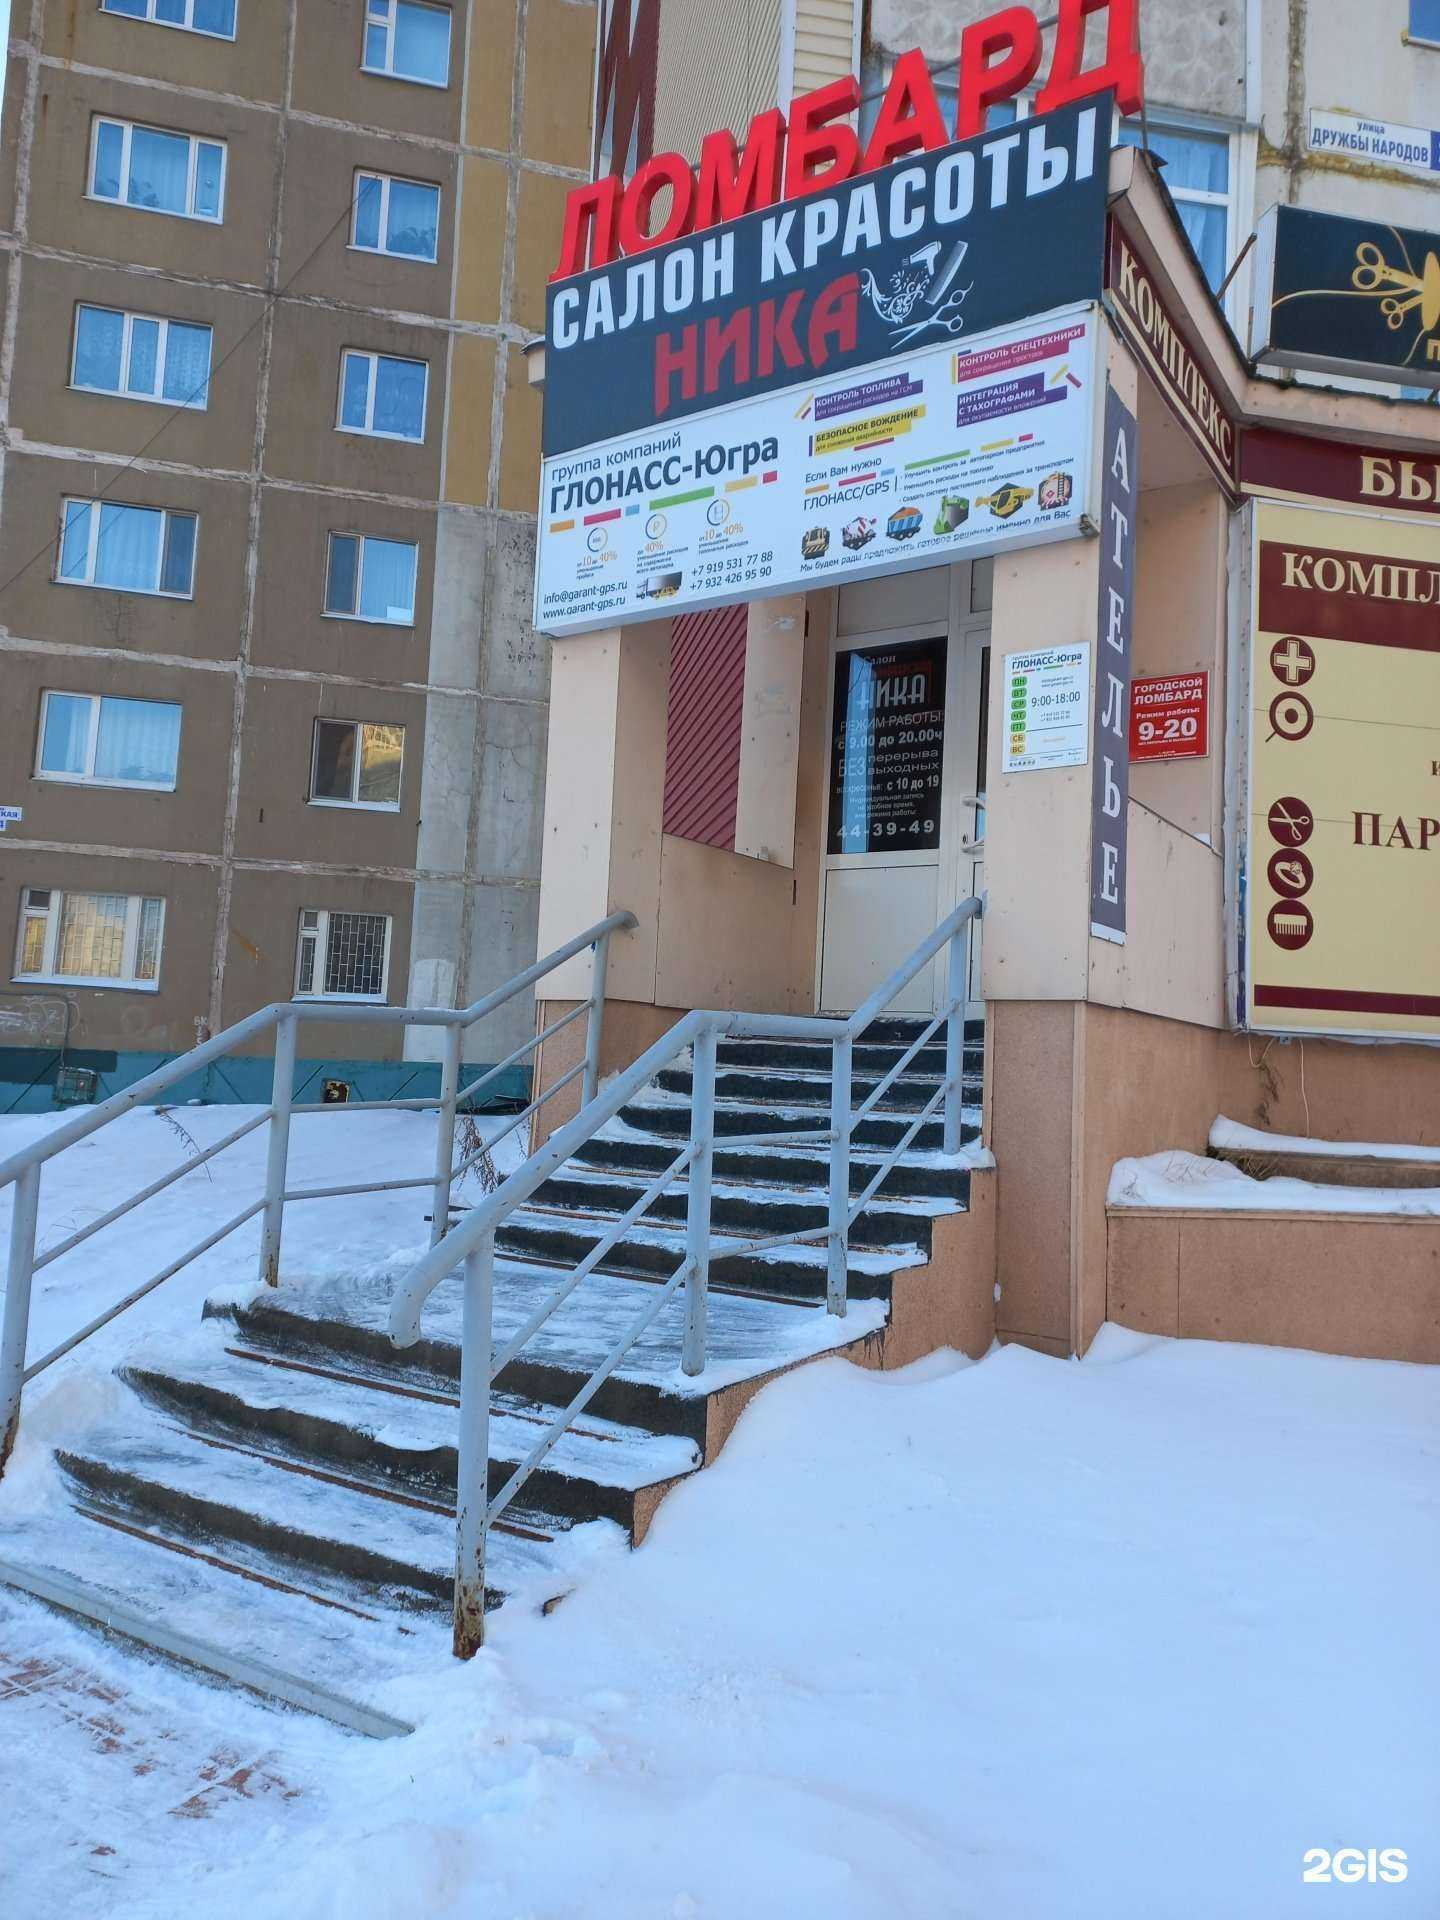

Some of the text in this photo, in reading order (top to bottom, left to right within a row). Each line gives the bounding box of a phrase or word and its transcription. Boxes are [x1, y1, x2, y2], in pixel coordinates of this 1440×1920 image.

[1357, 121, 1385, 135] улица
[549, 0, 1143, 283] ЛОМБАРД
[1312, 127, 1369, 152] ДРУЖБЫ
[1372, 140, 1428, 162] НАРОДОВ
[552, 106, 1097, 350] САЛОН КРАСОТЫ
[654, 271, 861, 417] НИКА
[960, 327, 1081, 368] КОНТРОЛЬ СПЕЦТЕХНИКИ
[1119, 241, 1232, 467] КОМПЛЕКС
[816, 378, 901, 408] КОНТРОЛЬ ТОПЛИВА
[959, 383, 1019, 405] ИНТЕГРАЦИЯ
[959, 389, 1036, 415] С ТАХОГРАФАМИ
[816, 408, 919, 443] БЕЗОПАСНОЕ ВОЖДЕНИЕ
[552, 431, 681, 482] группа компаний
[550, 436, 779, 514] ГЛОНАСС-Югра
[805, 458, 882, 484] Если Вам нужно
[804, 480, 890, 511] ГЛОНАСС/GPS
[800, 562, 812, 573] Мы
[815, 558, 840, 570] будем
[841, 552, 862, 567] рады
[864, 541, 915, 561] предложить
[1033, 514, 1051, 526] для
[1054, 508, 1072, 520] Вас
[691, 551, 774, 577] +7 919 531 77 88
[690, 565, 772, 592] +7 932 426 95 90
[543, 580, 628, 605] info@garant-gps.ru
[1012, 653, 1083, 670] ГЛОНАСС-Югра
[1100, 427, 1130, 905] АТЕЛЬЕ
[856, 673, 926, 711] НИКА
[1134, 677, 1203, 694] ГОРОДСКОЙ
[1134, 688, 1202, 705] ЛОМБАРД
[1031, 691, 1081, 708] 9:00-18:00
[840, 717, 886, 732] РЕЖИМ
[1136, 707, 1200, 720] Режим работы:
[838, 729, 942, 750] с 9.00 до 20.00ч
[1012, 734, 1023, 742] СБ
[1138, 716, 1198, 741] 9-20
[838, 749, 939, 777] БЕЗ перерыва
[868, 762, 940, 776] выходных
[886, 782, 893, 791] с
[896, 777, 909, 790] 10
[910, 779, 924, 792] до
[926, 774, 940, 788] 19
[1352, 811, 1440, 850] ПАР
